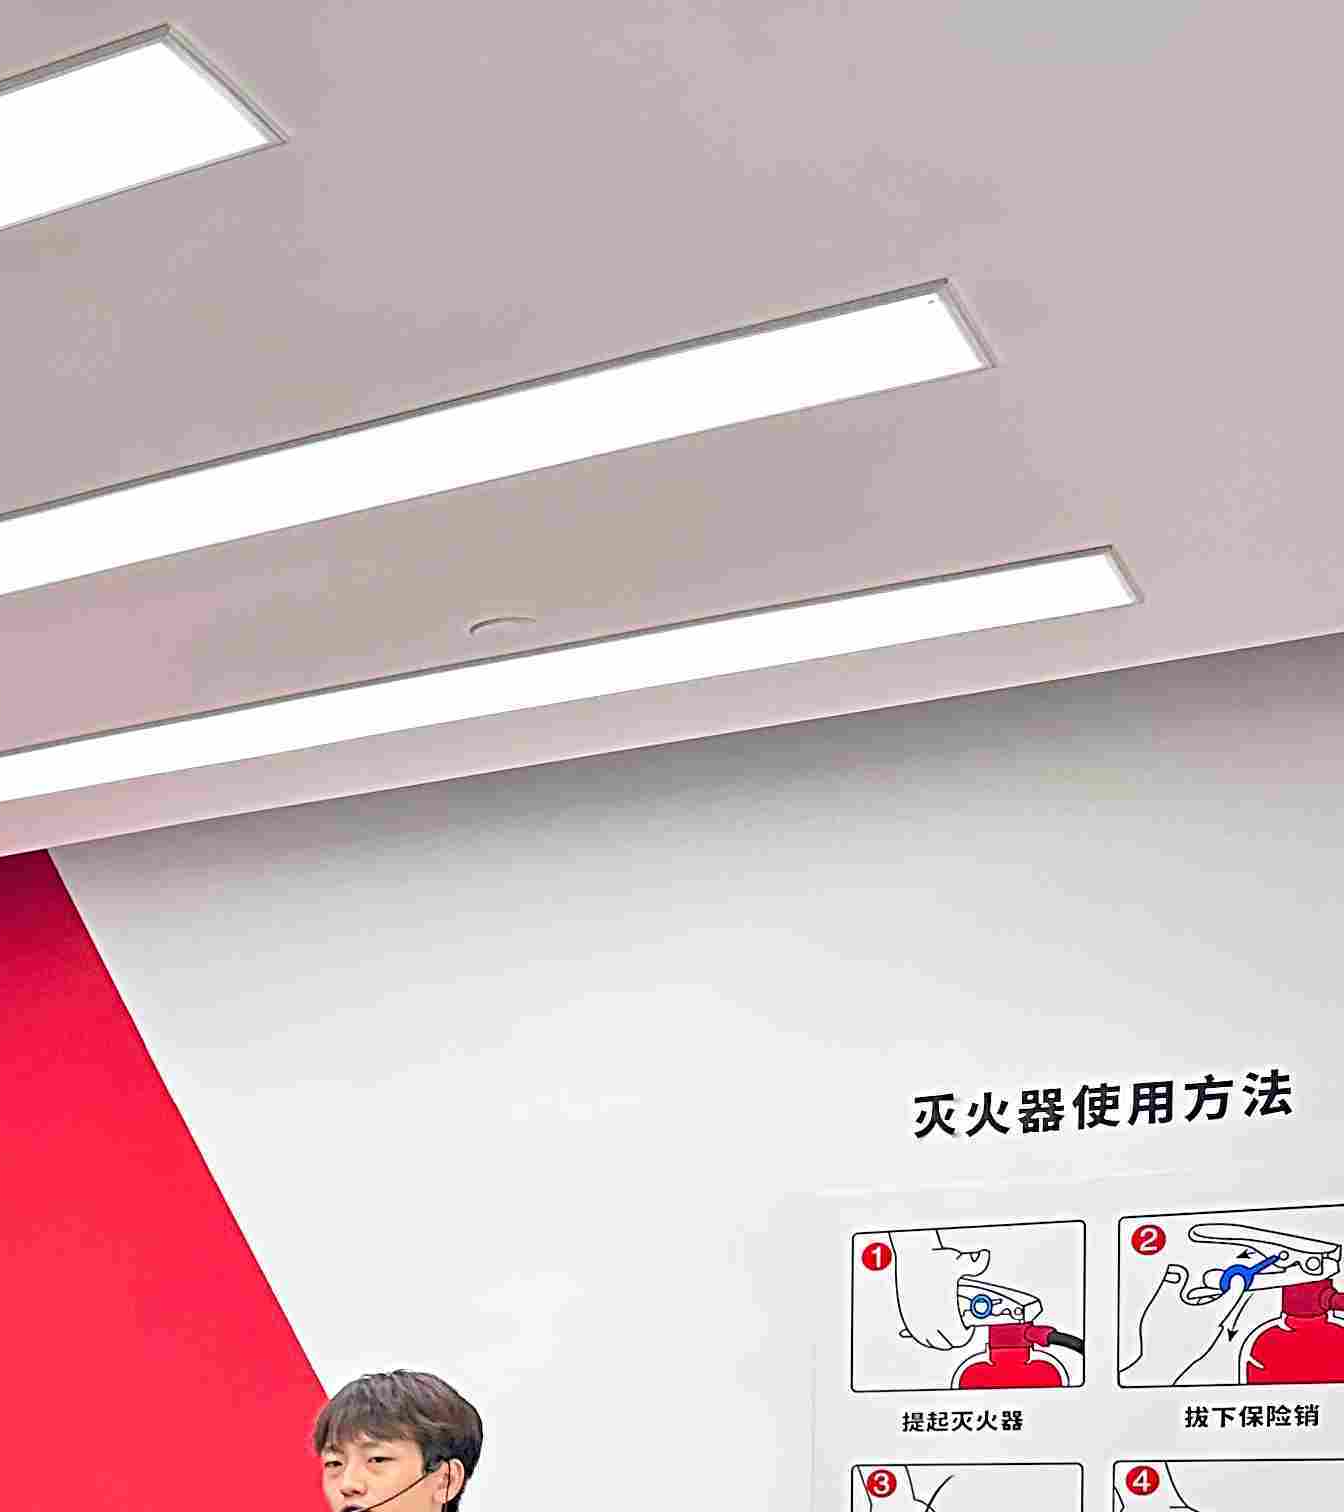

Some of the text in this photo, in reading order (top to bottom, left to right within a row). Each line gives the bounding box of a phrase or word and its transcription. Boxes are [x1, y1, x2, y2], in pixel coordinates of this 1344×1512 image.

[914, 1069, 1293, 1139] 灭火器使用方法
[902, 1409, 1024, 1433] 提起灭火器
[1184, 1403, 1320, 1428] 拔下保险销
